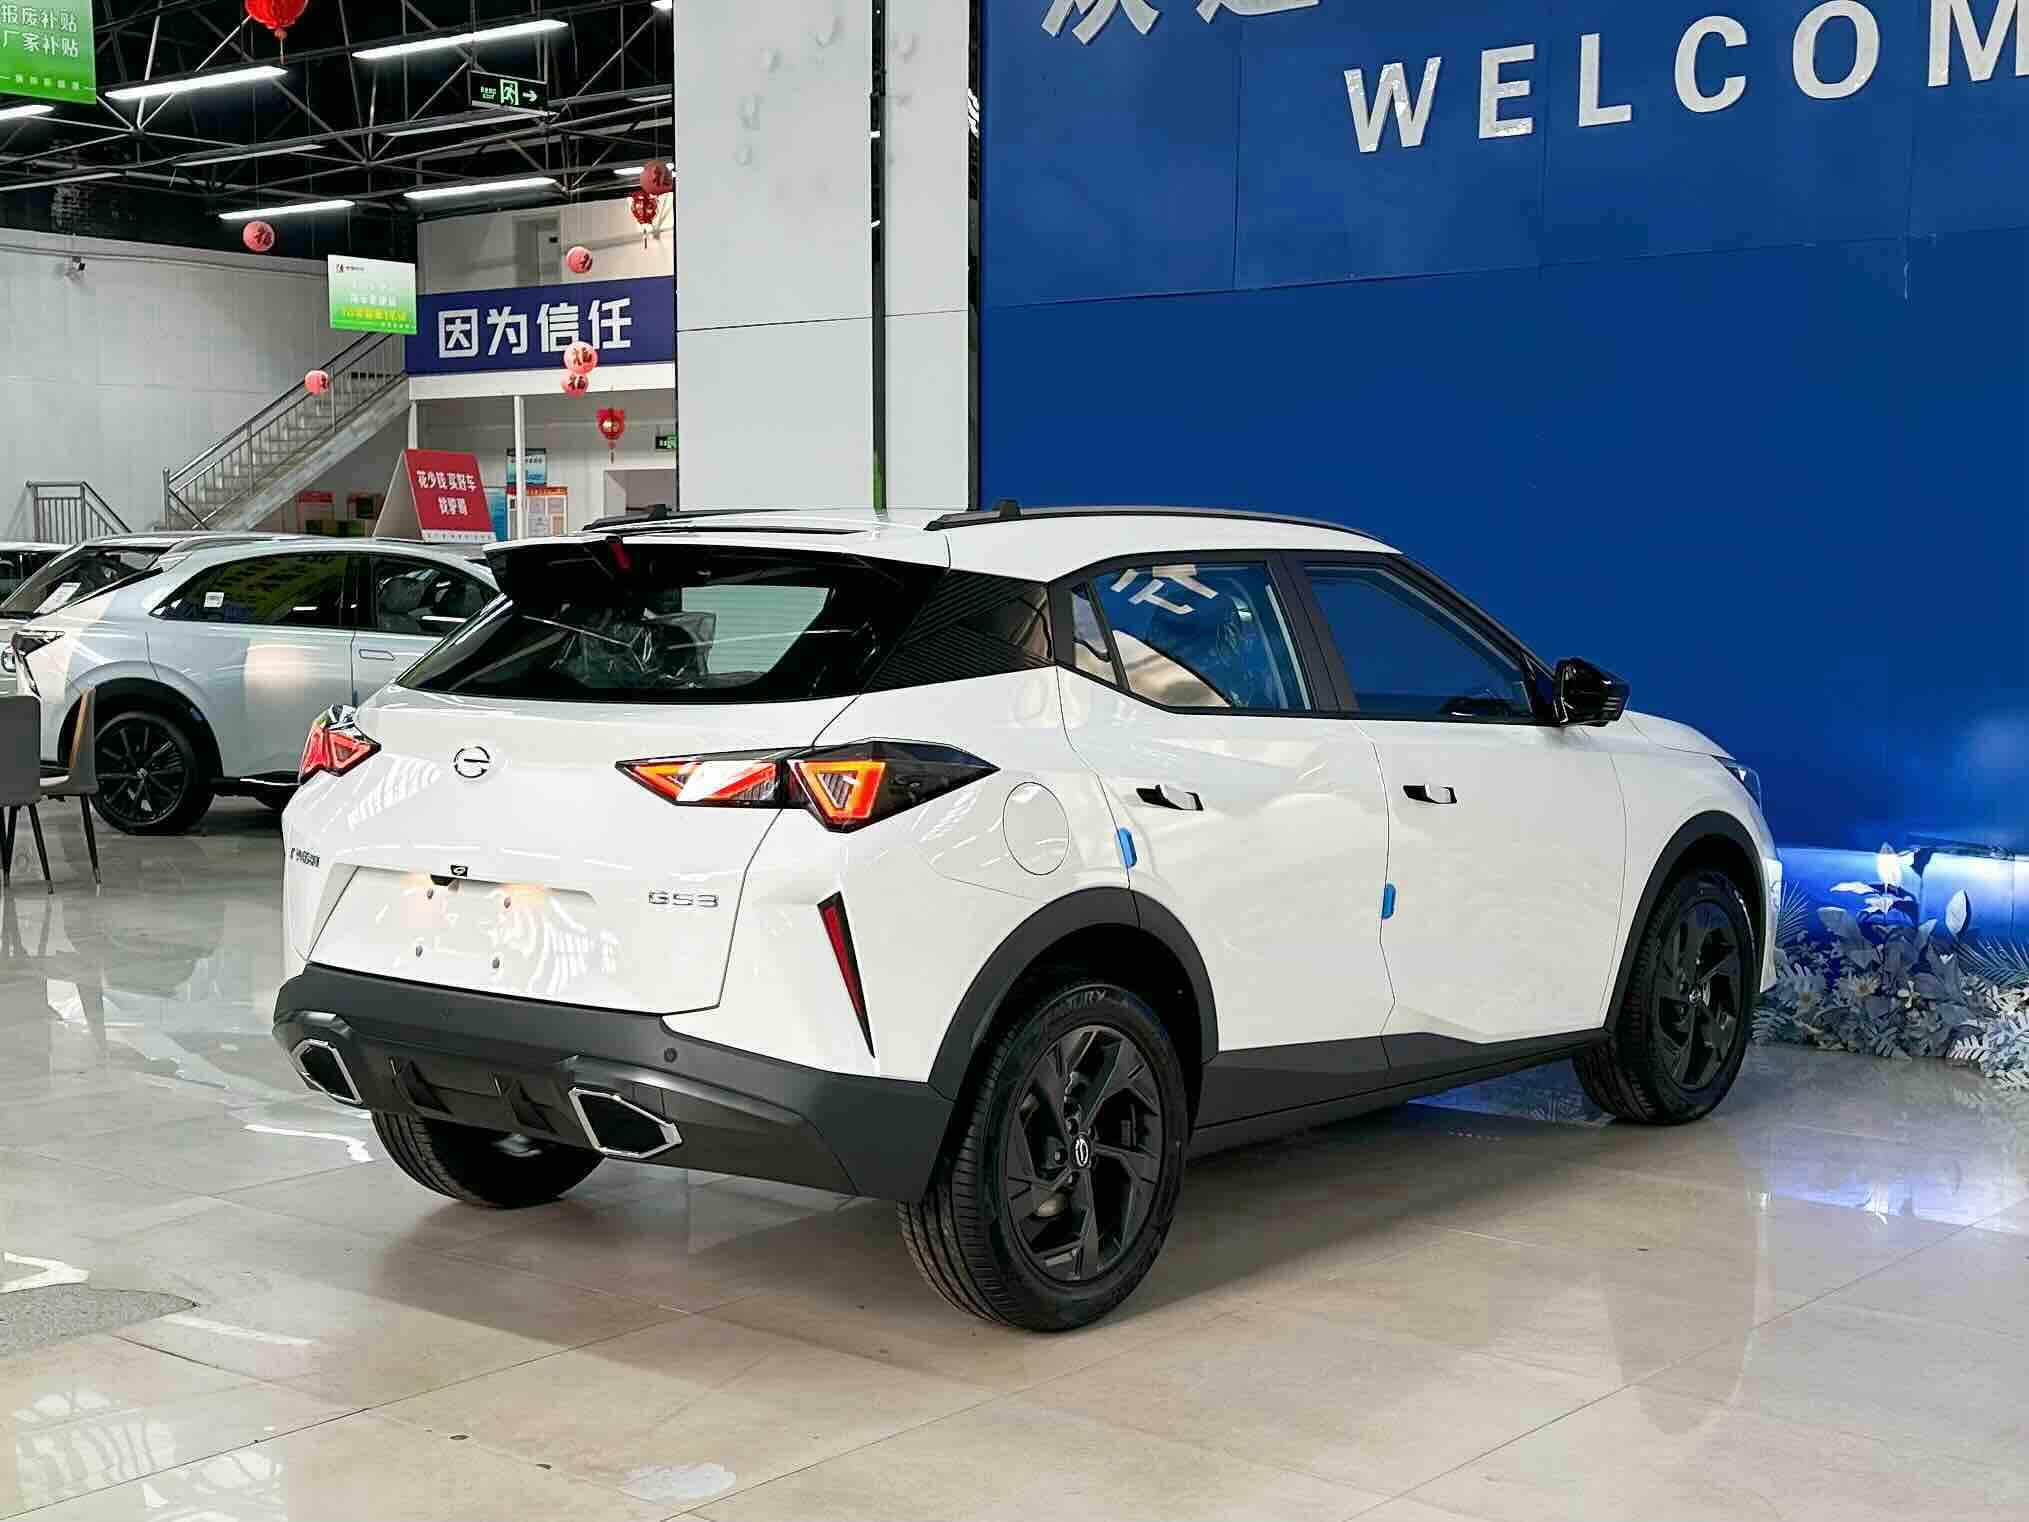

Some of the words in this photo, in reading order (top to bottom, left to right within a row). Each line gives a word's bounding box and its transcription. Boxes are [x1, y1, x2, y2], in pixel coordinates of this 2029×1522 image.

[2, 30, 79, 57] 厂家补贴
[437, 297, 633, 359] 因为信任
[647, 889, 719, 908] GS3
